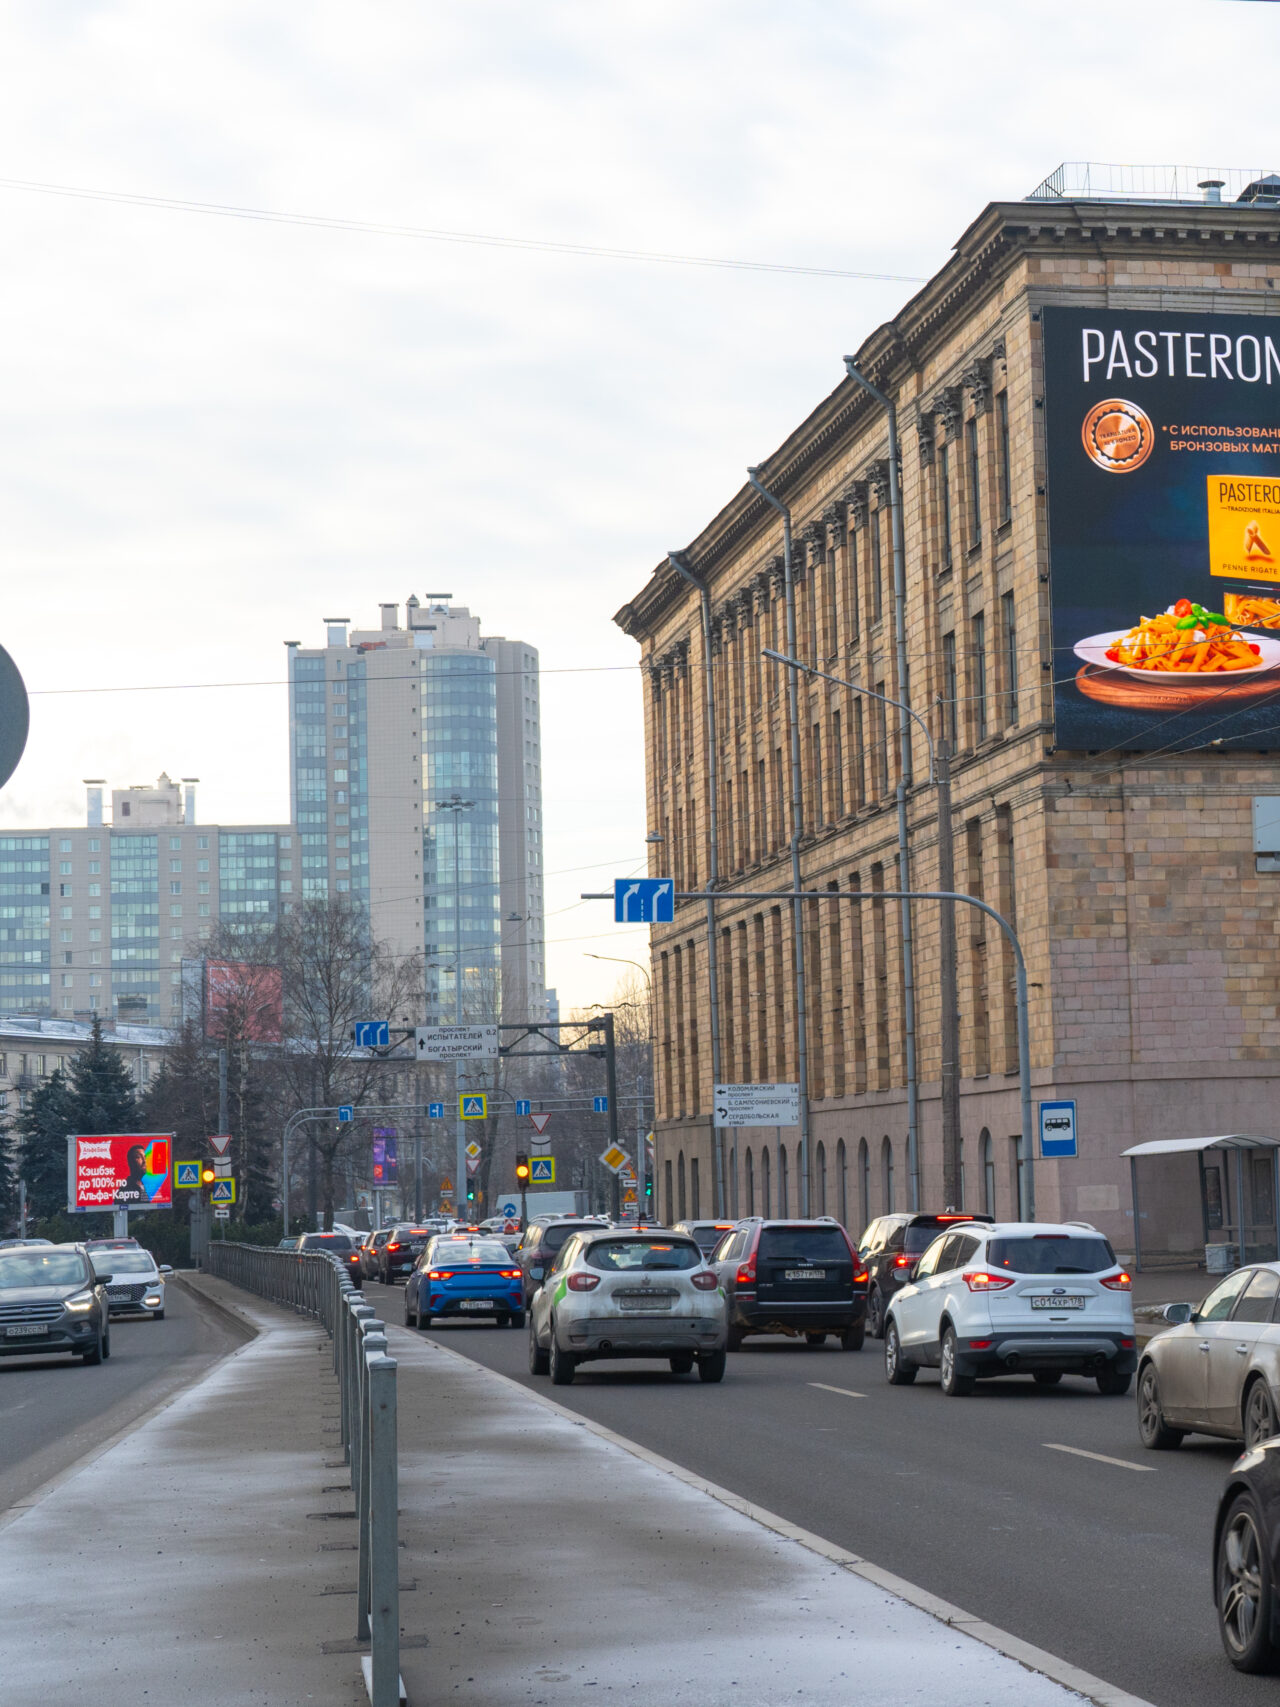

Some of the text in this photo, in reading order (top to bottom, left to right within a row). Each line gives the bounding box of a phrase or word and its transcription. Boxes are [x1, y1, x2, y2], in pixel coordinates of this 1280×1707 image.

[1170, 440, 1250, 453] БРОНЗОВЫХ
[1227, 505, 1261, 514] TRADIZIONE
[1222, 563, 1248, 573] PENNE
[1250, 566, 1278, 575] RIGATE
[427, 1032, 483, 1041] ИСПЫТАТЕЛЕЙ
[428, 1043, 483, 1053] БОГАТЫРСКИЙ
[78, 1165, 115, 1177] Кэшбэк
[78, 1178, 127, 1190] до 100% по
[79, 1189, 140, 1203] Альфа-Карте
